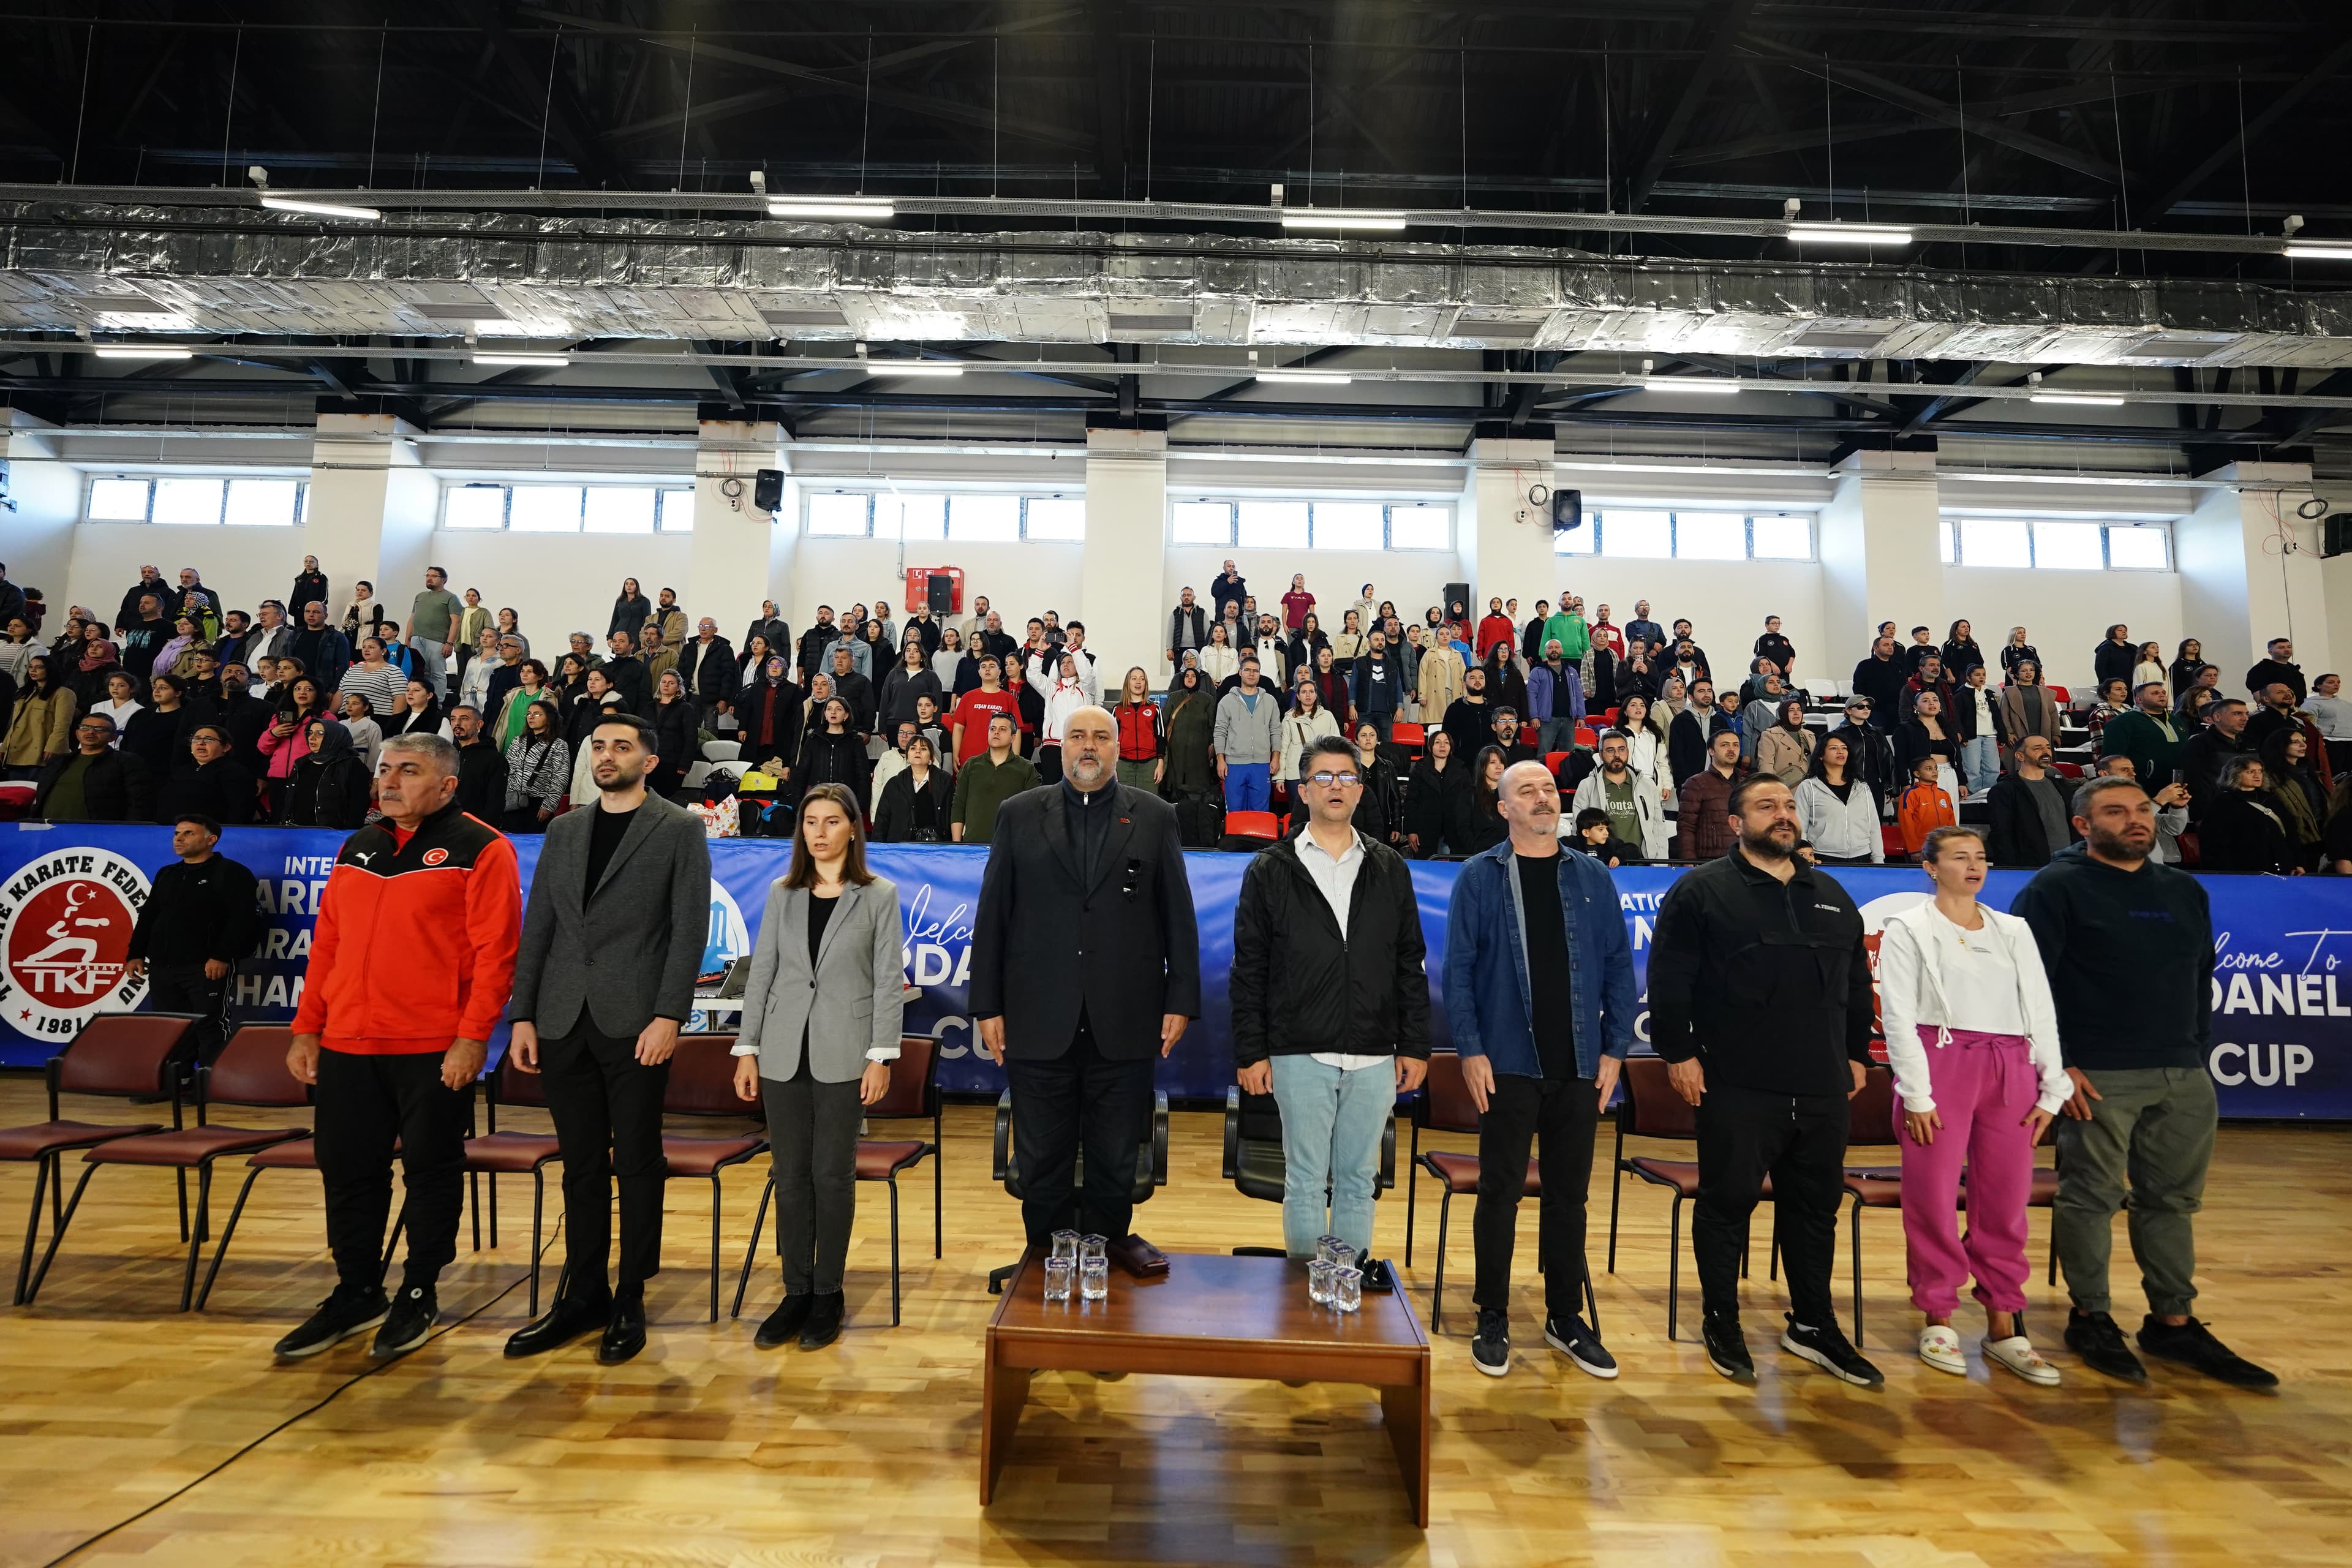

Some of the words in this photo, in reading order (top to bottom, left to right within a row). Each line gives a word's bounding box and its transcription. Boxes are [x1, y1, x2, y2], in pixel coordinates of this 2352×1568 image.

[9, 856, 94, 902] KARATE
[101, 861, 148, 914] FEDE
[2285, 927, 2352, 981] To
[22, 968, 116, 995] TKF
[36, 1016, 84, 1034] 1981
[2209, 1042, 2314, 1087] CUP
